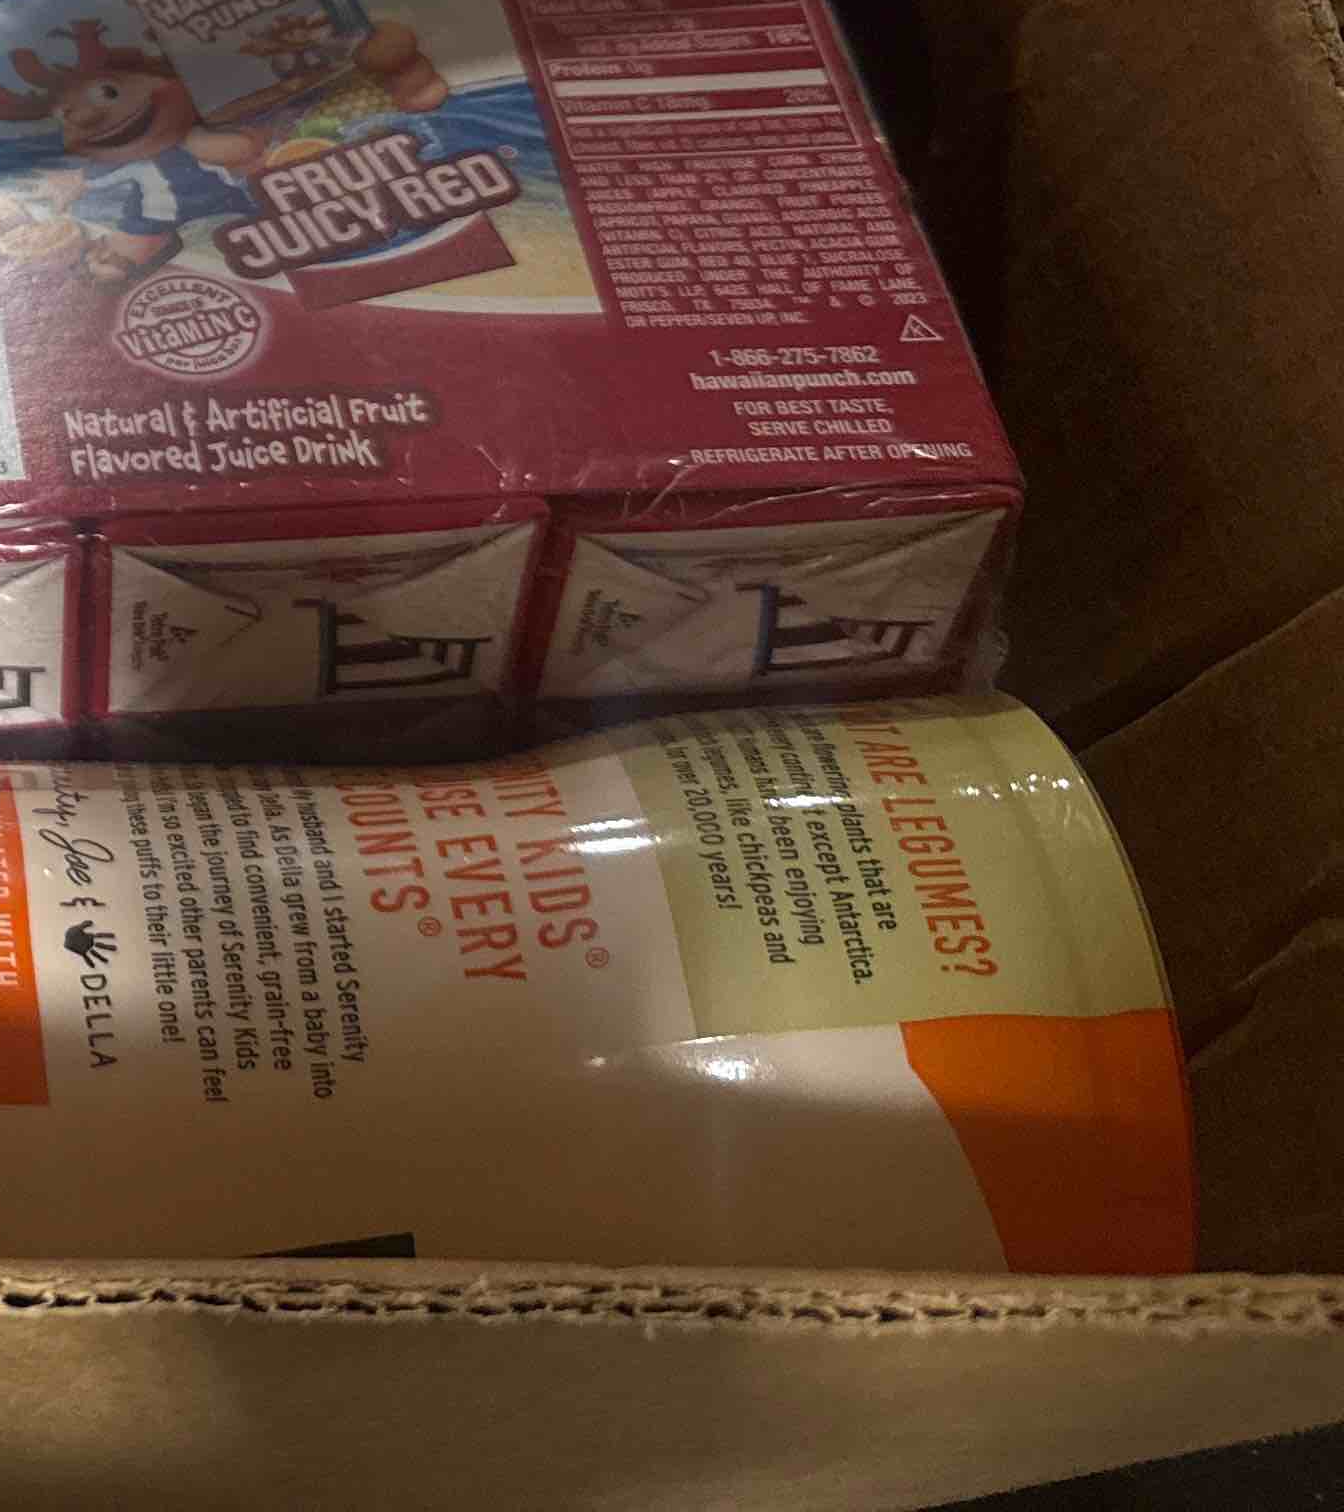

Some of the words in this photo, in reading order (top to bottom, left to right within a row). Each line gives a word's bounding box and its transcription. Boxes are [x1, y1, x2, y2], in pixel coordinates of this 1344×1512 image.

[263, 135, 420, 213] FRUIT
[229, 209, 386, 274] JUICY
[401, 152, 513, 232] RED
[691, 368, 917, 393] hawaiianpunch.com
[710, 346, 881, 366] 1-866-275-7862
[63, 405, 174, 440] Natural
[204, 395, 338, 433] Artificial
[350, 393, 429, 423] Fruit
[734, 400, 772, 418] FOR
[776, 400, 819, 416] BEST
[749, 419, 808, 437] SERVE
[812, 417, 892, 435] CHILLED
[71, 440, 200, 474] Flavored
[210, 440, 282, 471] Juice
[293, 434, 376, 468] Drink
[689, 444, 817, 465] REFRIGERATE
[824, 444, 880, 462] AFTER
[885, 443, 973, 460] OPENING
[435, 833, 527, 982] EVERY
[880, 796, 998, 980] LEGUMES?
[828, 889, 875, 985] Antarctica.
[79, 973, 116, 1070] DELLA
[257, 970, 295, 1070] grain-free
